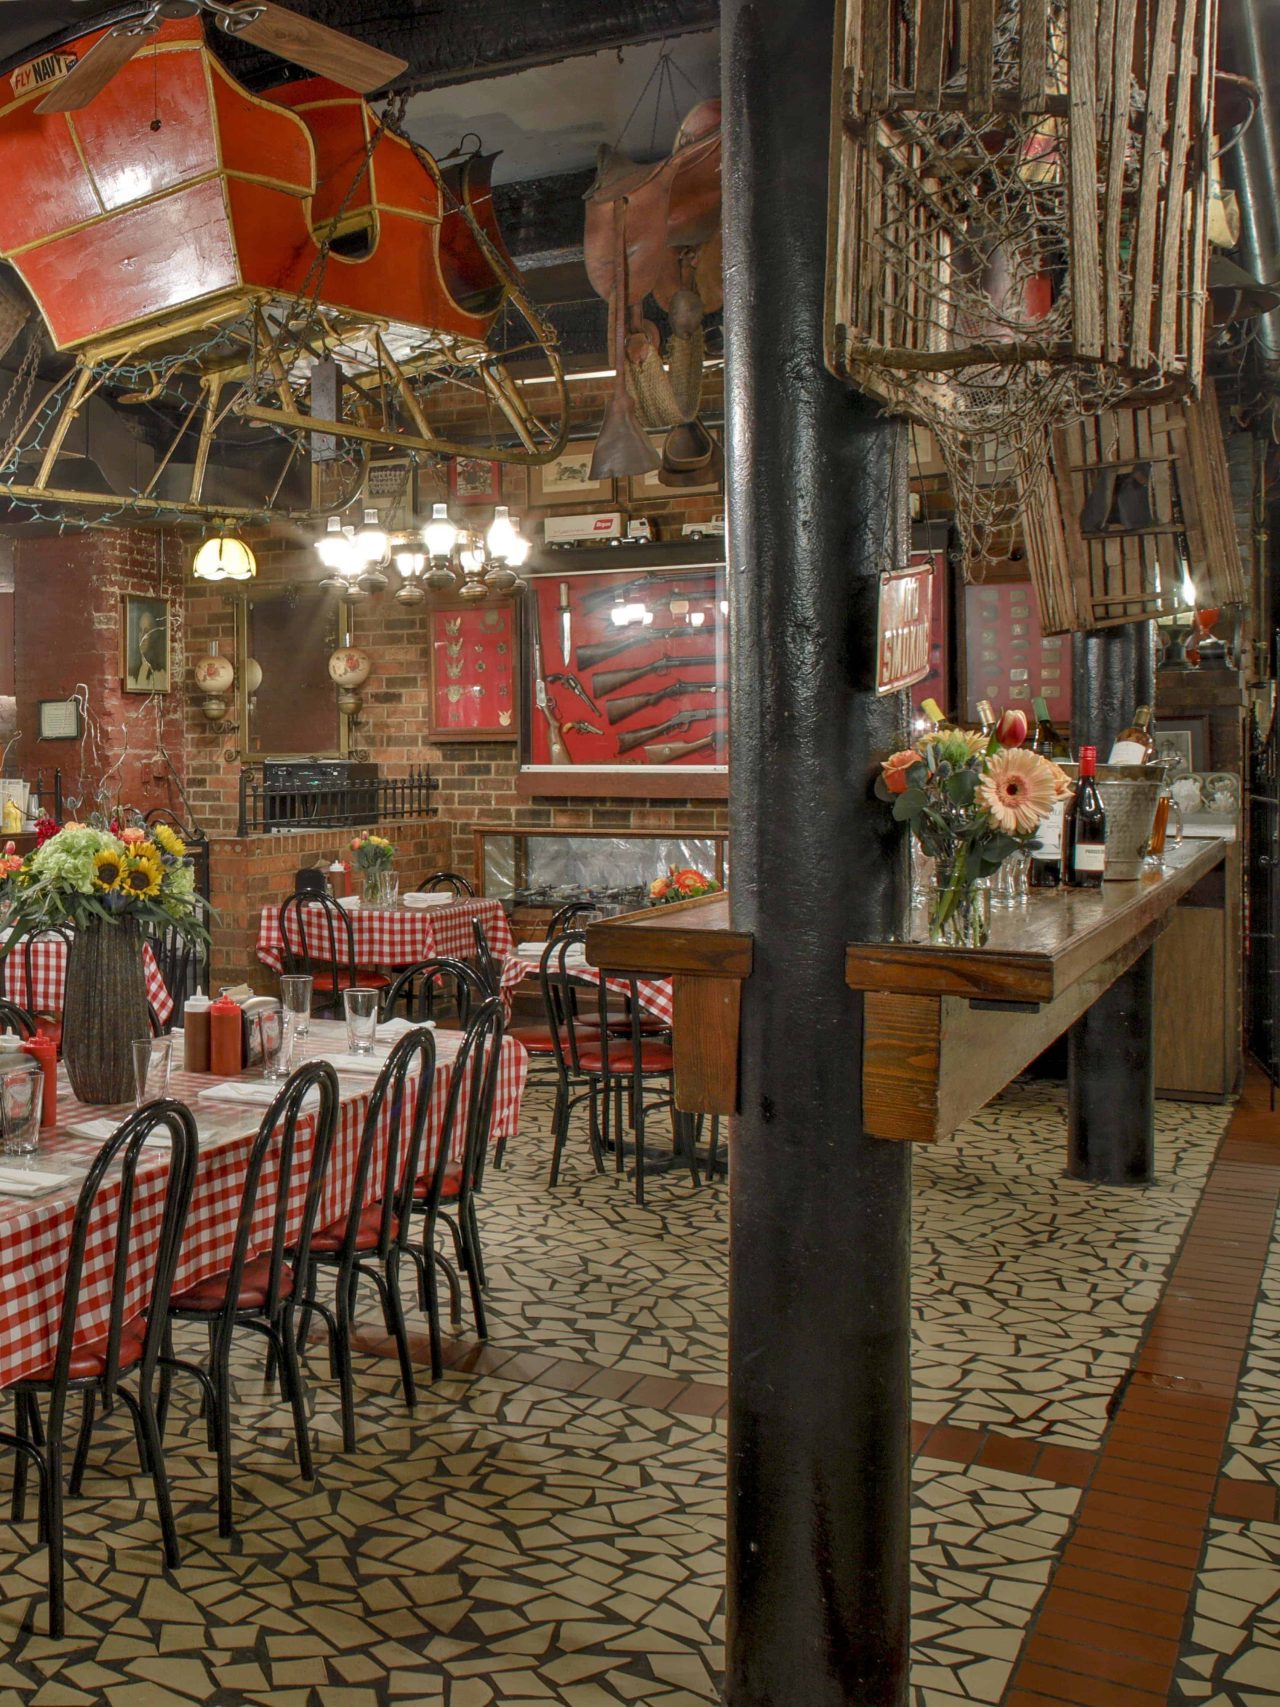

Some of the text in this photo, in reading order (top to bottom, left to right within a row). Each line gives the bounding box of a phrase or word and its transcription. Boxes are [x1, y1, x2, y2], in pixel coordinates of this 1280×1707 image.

[15, 54, 62, 89] FLY NAVY
[883, 621, 928, 682] SMOKING
